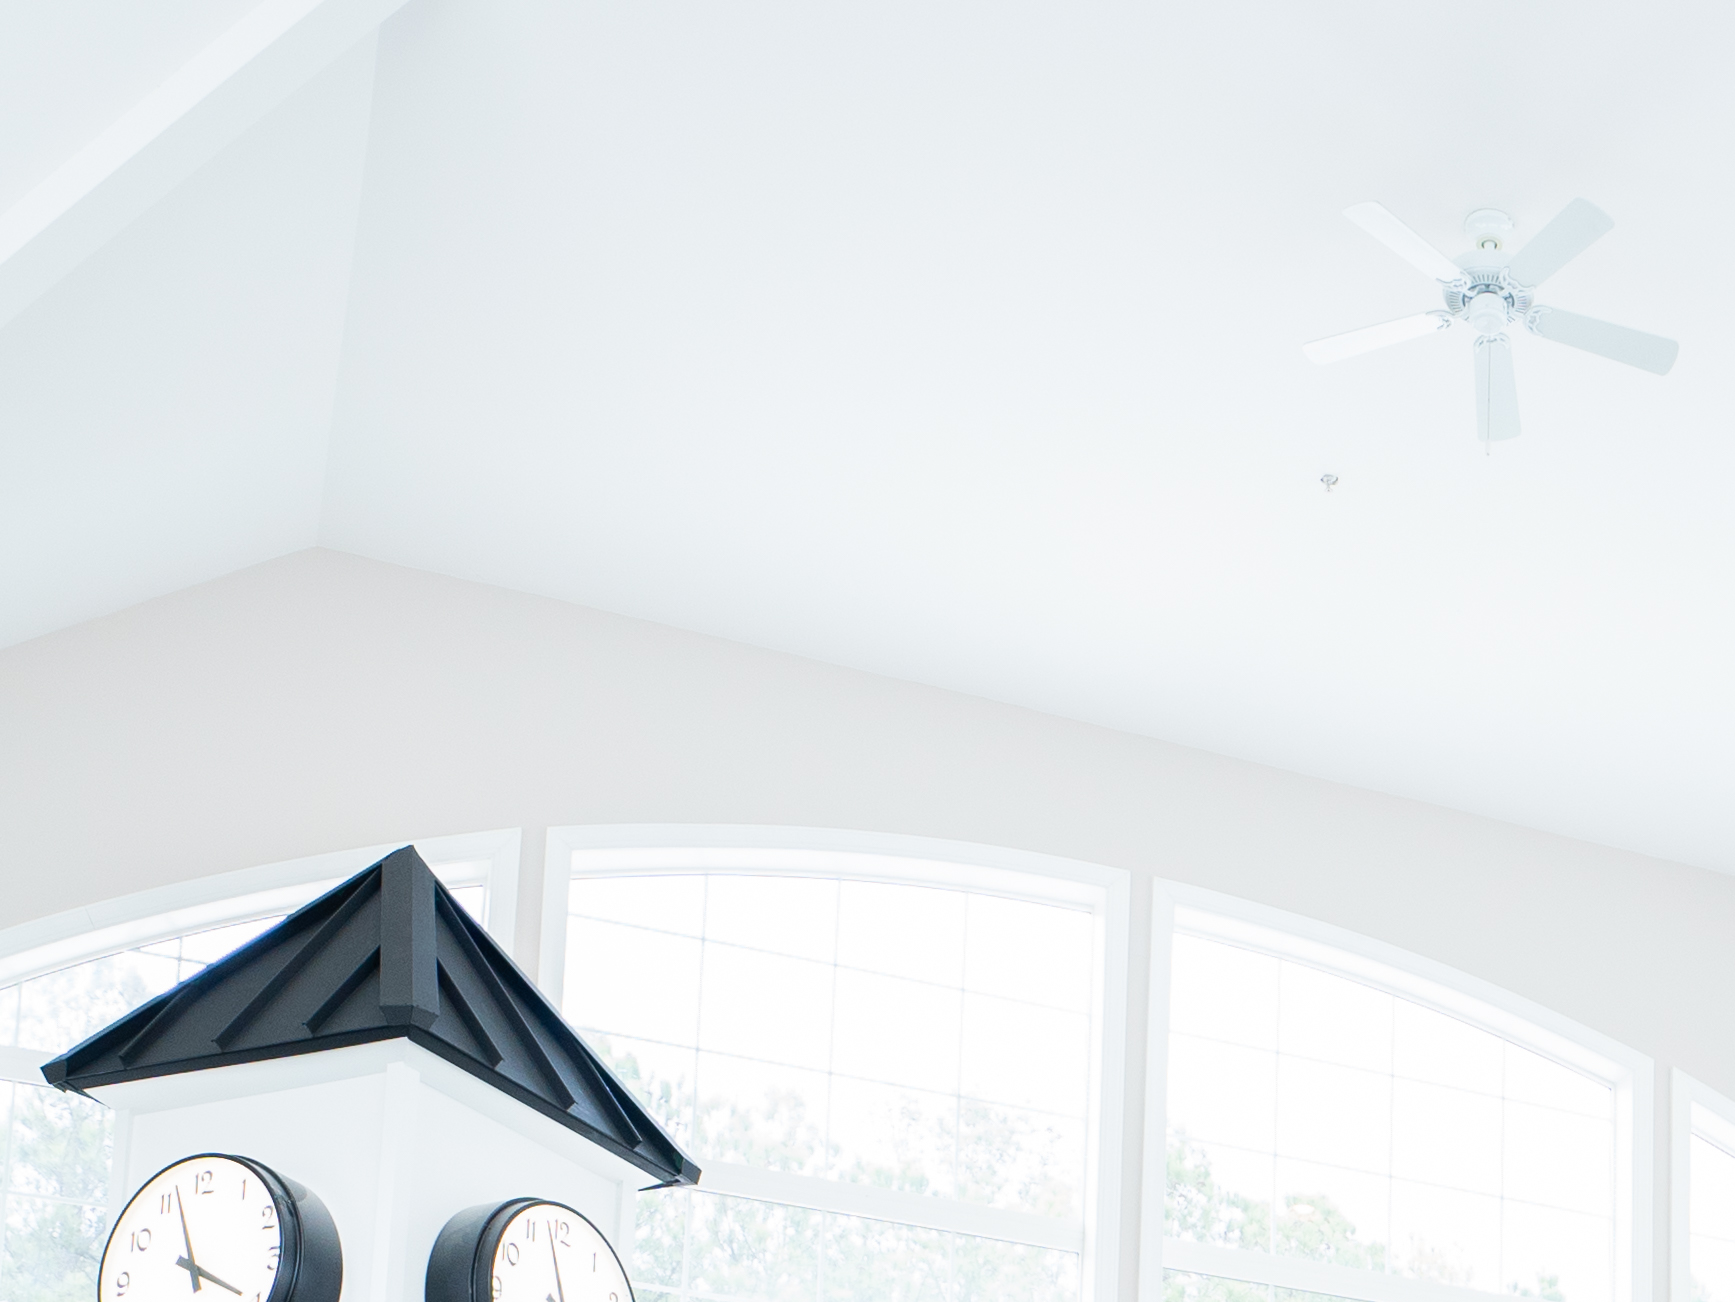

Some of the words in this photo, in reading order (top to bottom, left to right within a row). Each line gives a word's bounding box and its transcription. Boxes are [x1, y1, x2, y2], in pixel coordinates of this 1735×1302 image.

[194, 1170, 214, 1195] 12
[241, 1179, 247, 1201] 1
[160, 1193, 172, 1215] 11
[261, 1204, 275, 1230] 2
[130, 1228, 152, 1253] 10
[526, 1218, 536, 1242] 11
[554, 1218, 571, 1248] 12
[267, 1245, 281, 1271] 3
[502, 1241, 520, 1266] 10
[592, 1251, 597, 1273] 1
[116, 1271, 130, 1297] 9
